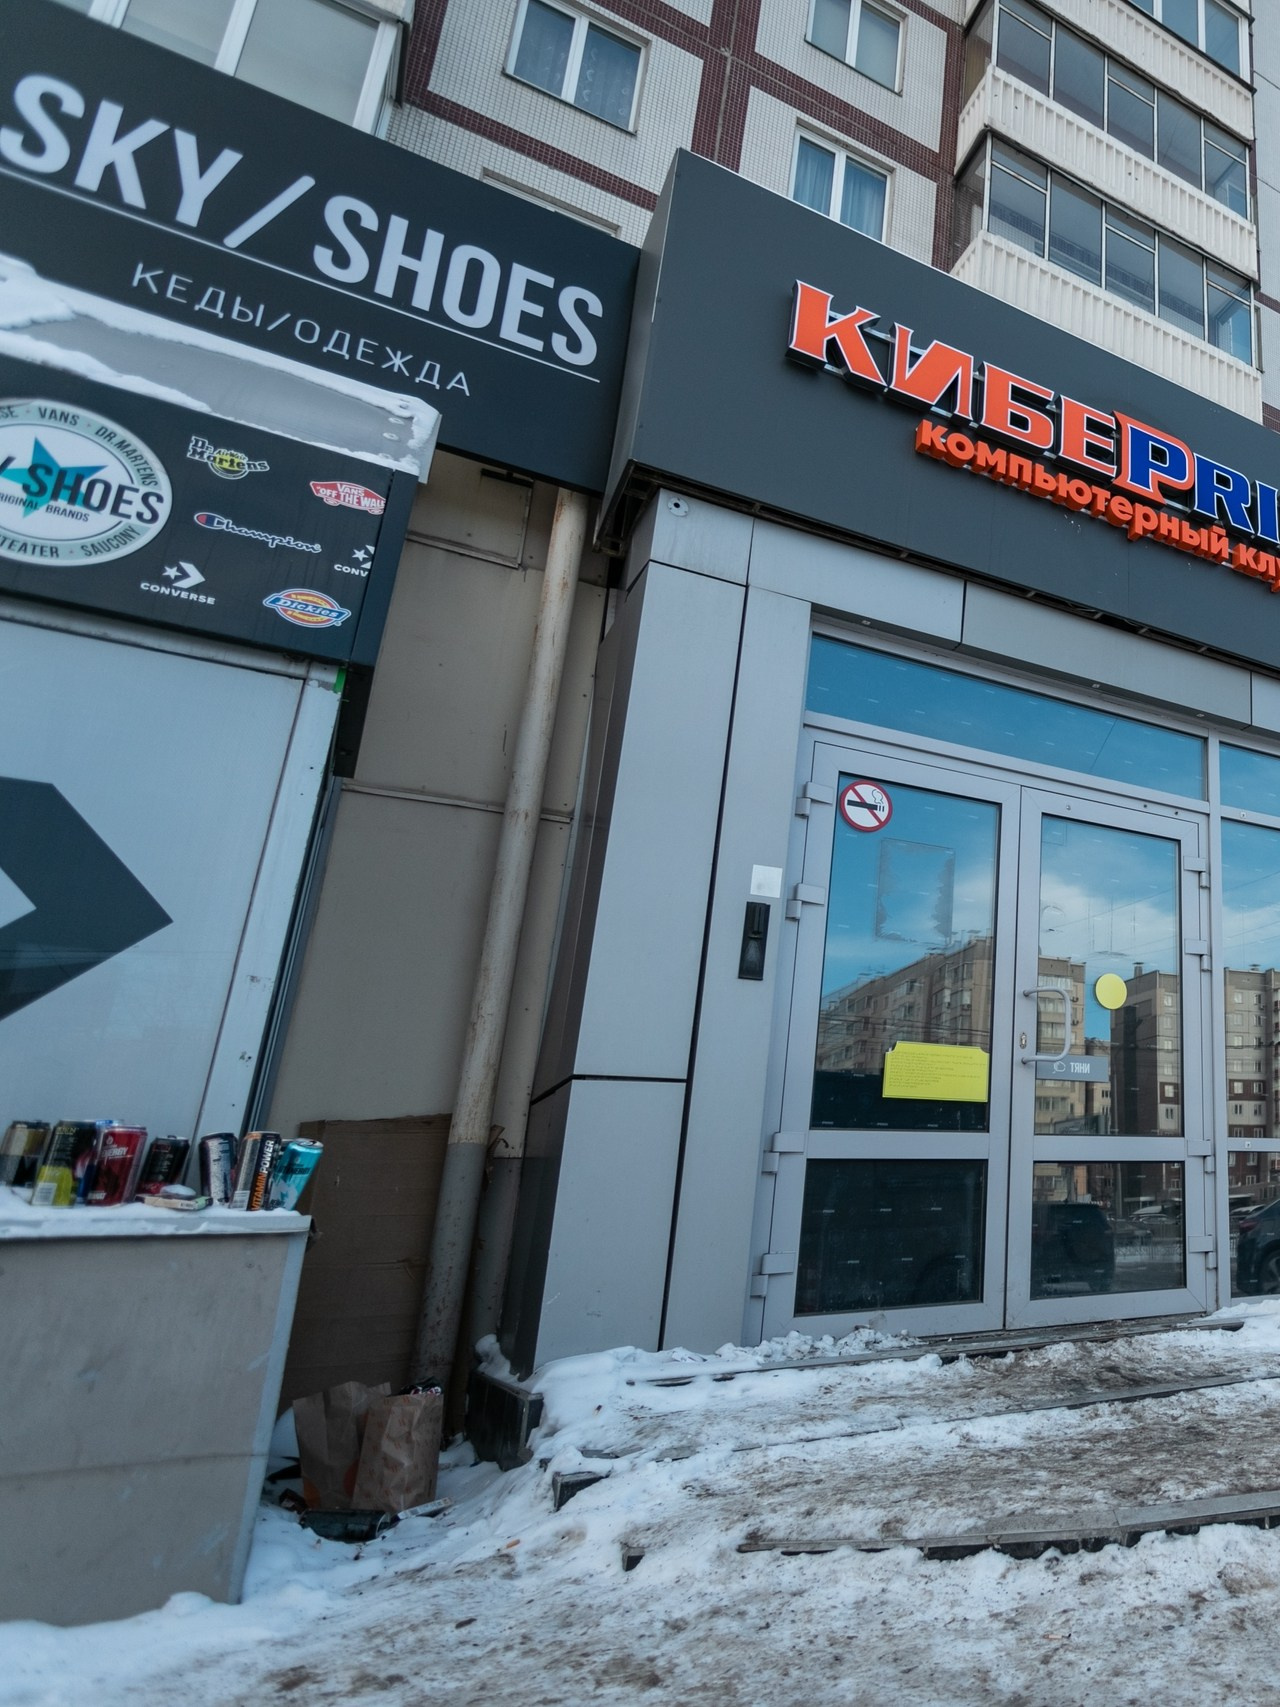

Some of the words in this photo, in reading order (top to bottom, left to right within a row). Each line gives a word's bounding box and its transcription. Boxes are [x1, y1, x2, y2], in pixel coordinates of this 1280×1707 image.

[38, 406, 80, 426] VANS
[187, 447, 270, 471] Martens
[22, 463, 164, 525] SHOES
[337, 483, 365, 497] VANS
[340, 492, 360, 506] THE
[45, 504, 90, 522] BRANDS
[81, 525, 141, 557] SAUCONY
[194, 512, 322, 553] Champion
[140, 582, 216, 605] CONVERSE
[275, 598, 340, 618] Dickies
[1070, 1062, 1091, 1074] ТЯНИ
